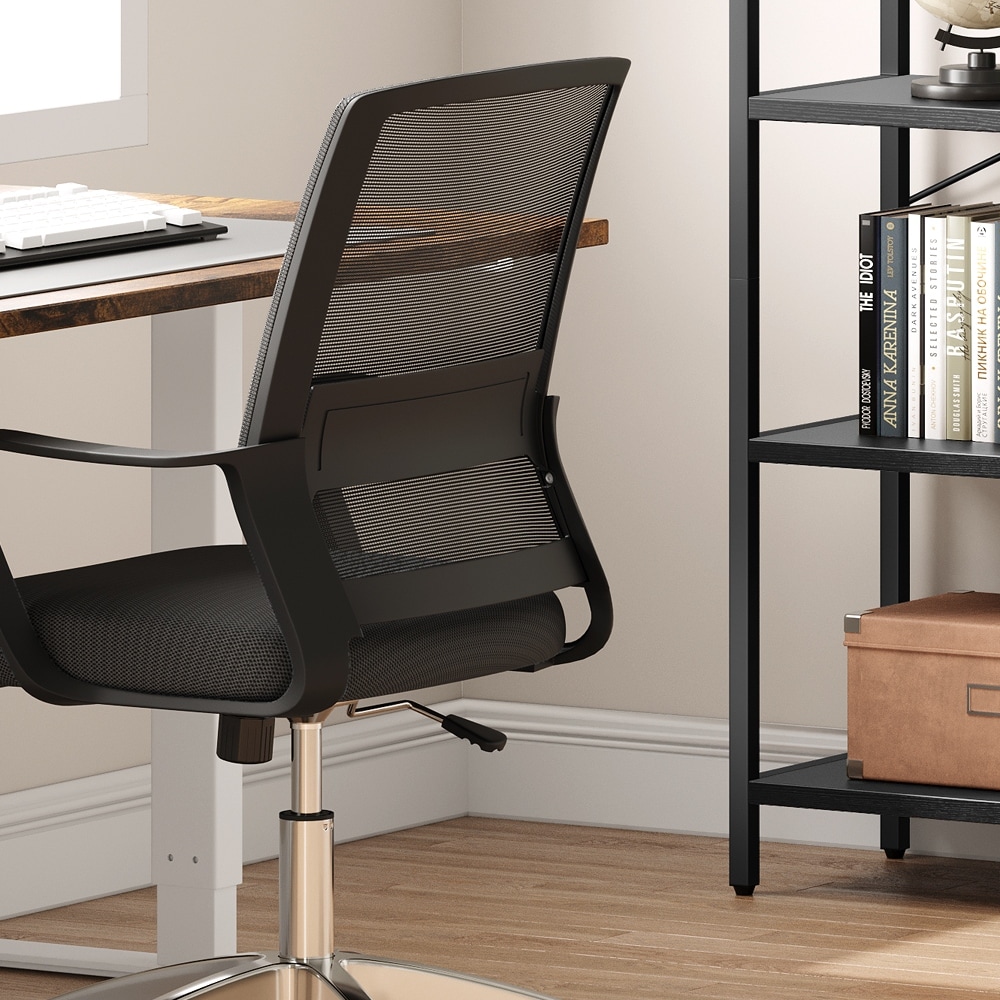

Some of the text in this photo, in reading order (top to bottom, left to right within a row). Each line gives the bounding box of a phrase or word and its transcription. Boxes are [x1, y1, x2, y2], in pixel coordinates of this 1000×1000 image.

[860, 253, 873, 311] THE IDIOT
[930, 299, 938, 357] SELECTED
[977, 247, 988, 379] ПИКНИК НА ОБОЧИНЕ
[884, 290, 897, 428] ANNA KARENINA
[862, 369, 871, 429] FYODOR DOSTOEVSKY
